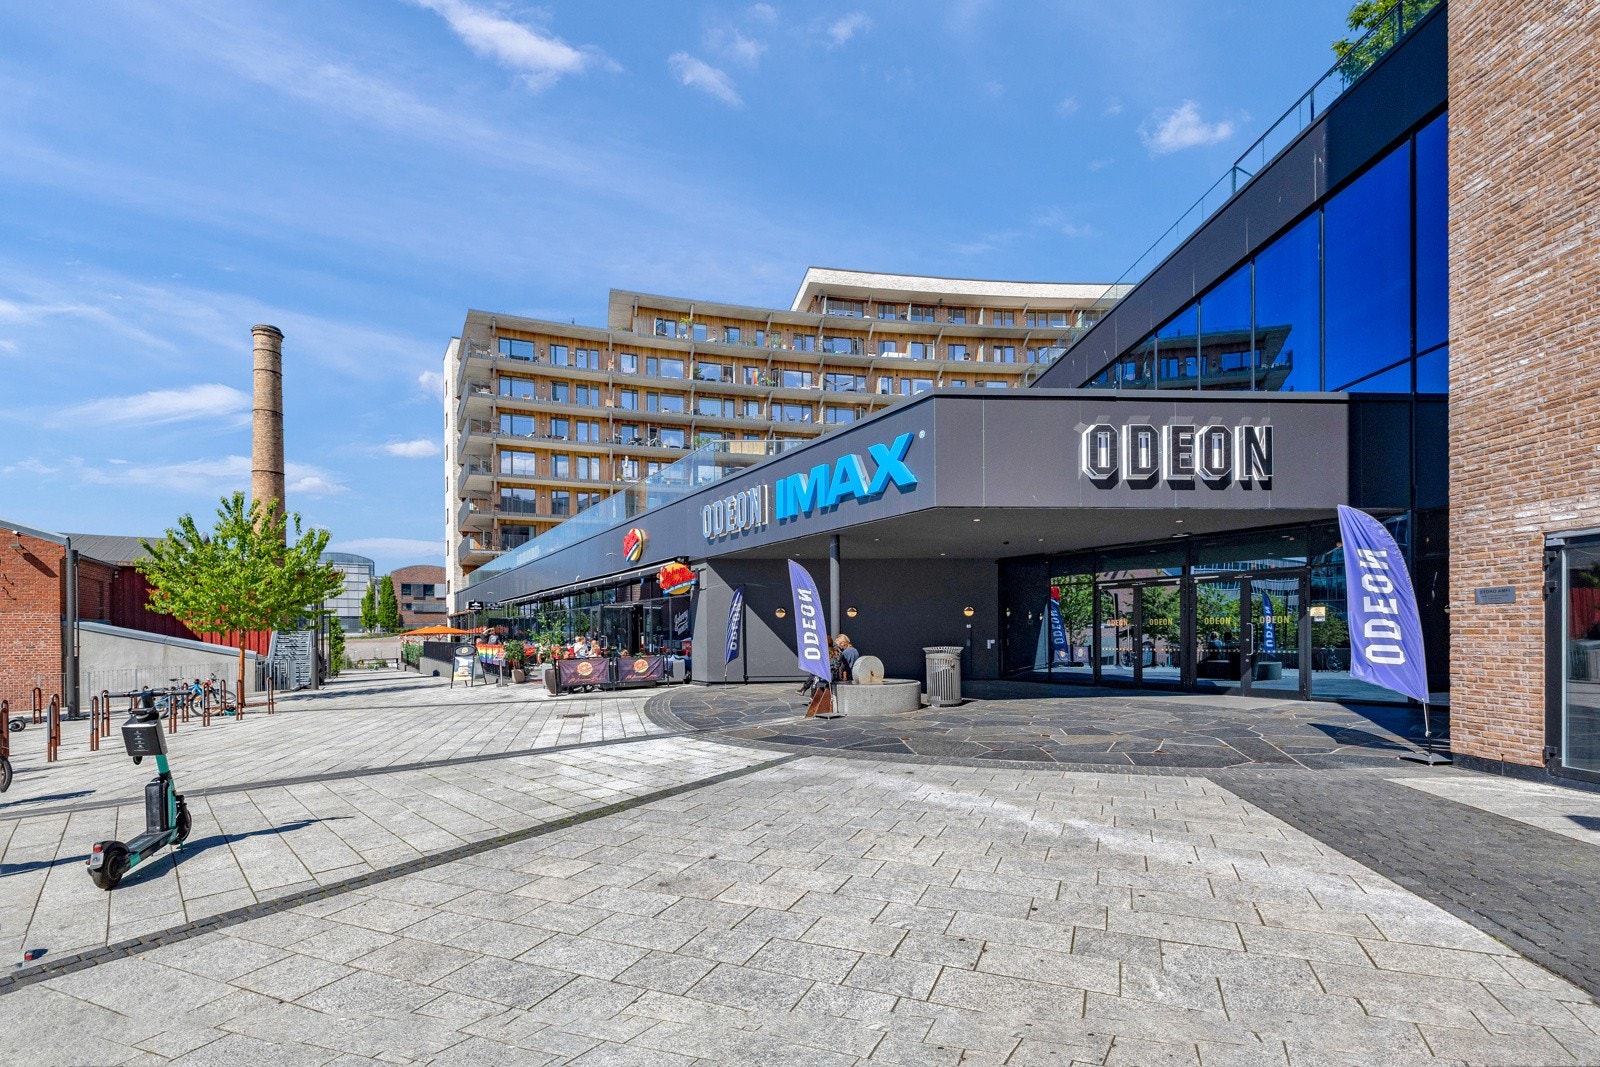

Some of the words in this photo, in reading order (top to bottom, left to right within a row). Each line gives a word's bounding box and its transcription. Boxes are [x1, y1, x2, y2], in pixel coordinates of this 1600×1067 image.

[1082, 423, 1274, 479] ODEON
[702, 486, 764, 540] ODEON
[776, 432, 918, 520] IMAX
[1106, 618, 1128, 627] ODEON
[1149, 618, 1173, 626] ODEON
[1204, 616, 1232, 625] ODEON
[1259, 615, 1291, 624] ODEON
